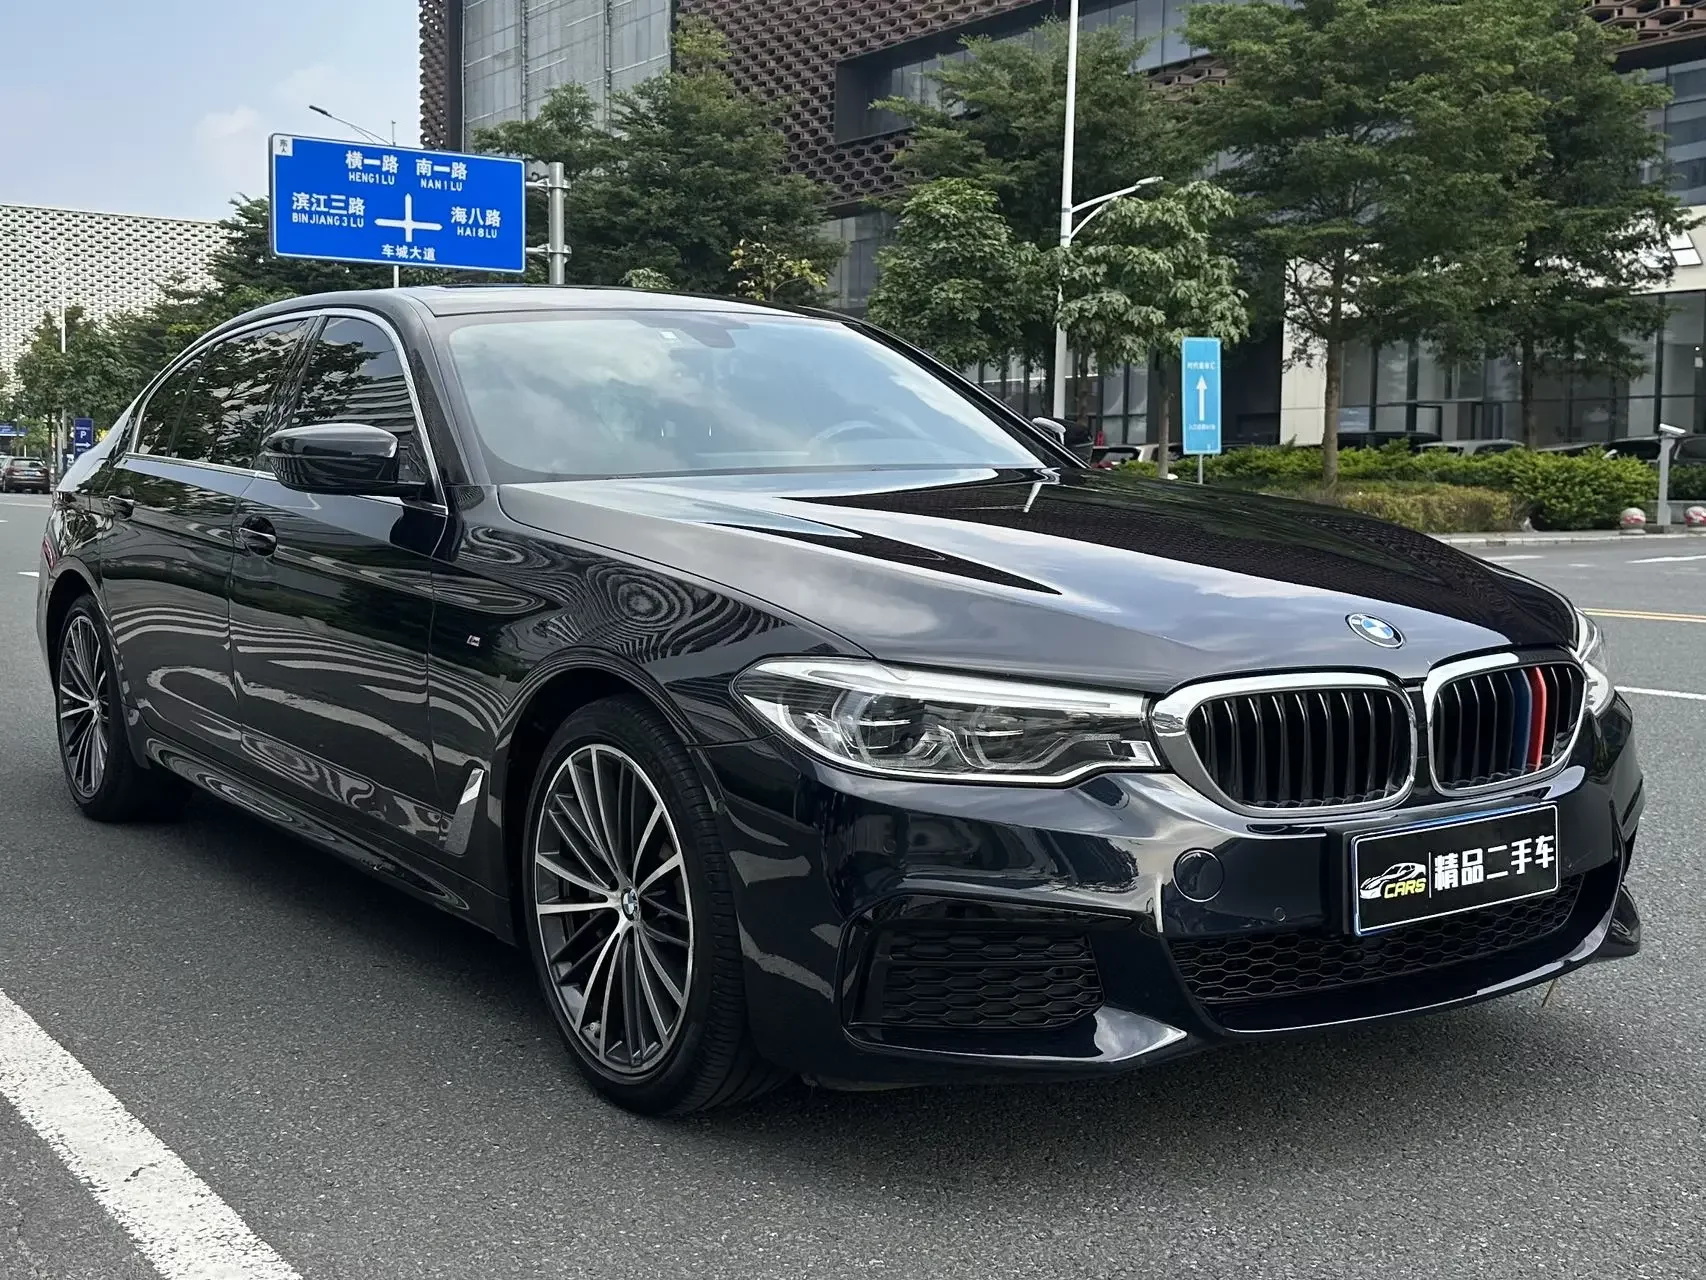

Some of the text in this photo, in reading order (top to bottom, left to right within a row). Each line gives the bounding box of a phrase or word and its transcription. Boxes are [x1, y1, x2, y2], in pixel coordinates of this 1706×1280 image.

[345, 150, 399, 174] 横一路
[415, 158, 468, 180] 南一路
[292, 191, 366, 216] 滨江三路
[450, 206, 501, 228] 海八路
[381, 243, 436, 261] 车城大道
[80, 430, 87, 439] P
[1434, 834, 1555, 891] 精品二手车
[1383, 877, 1427, 899] CARS
